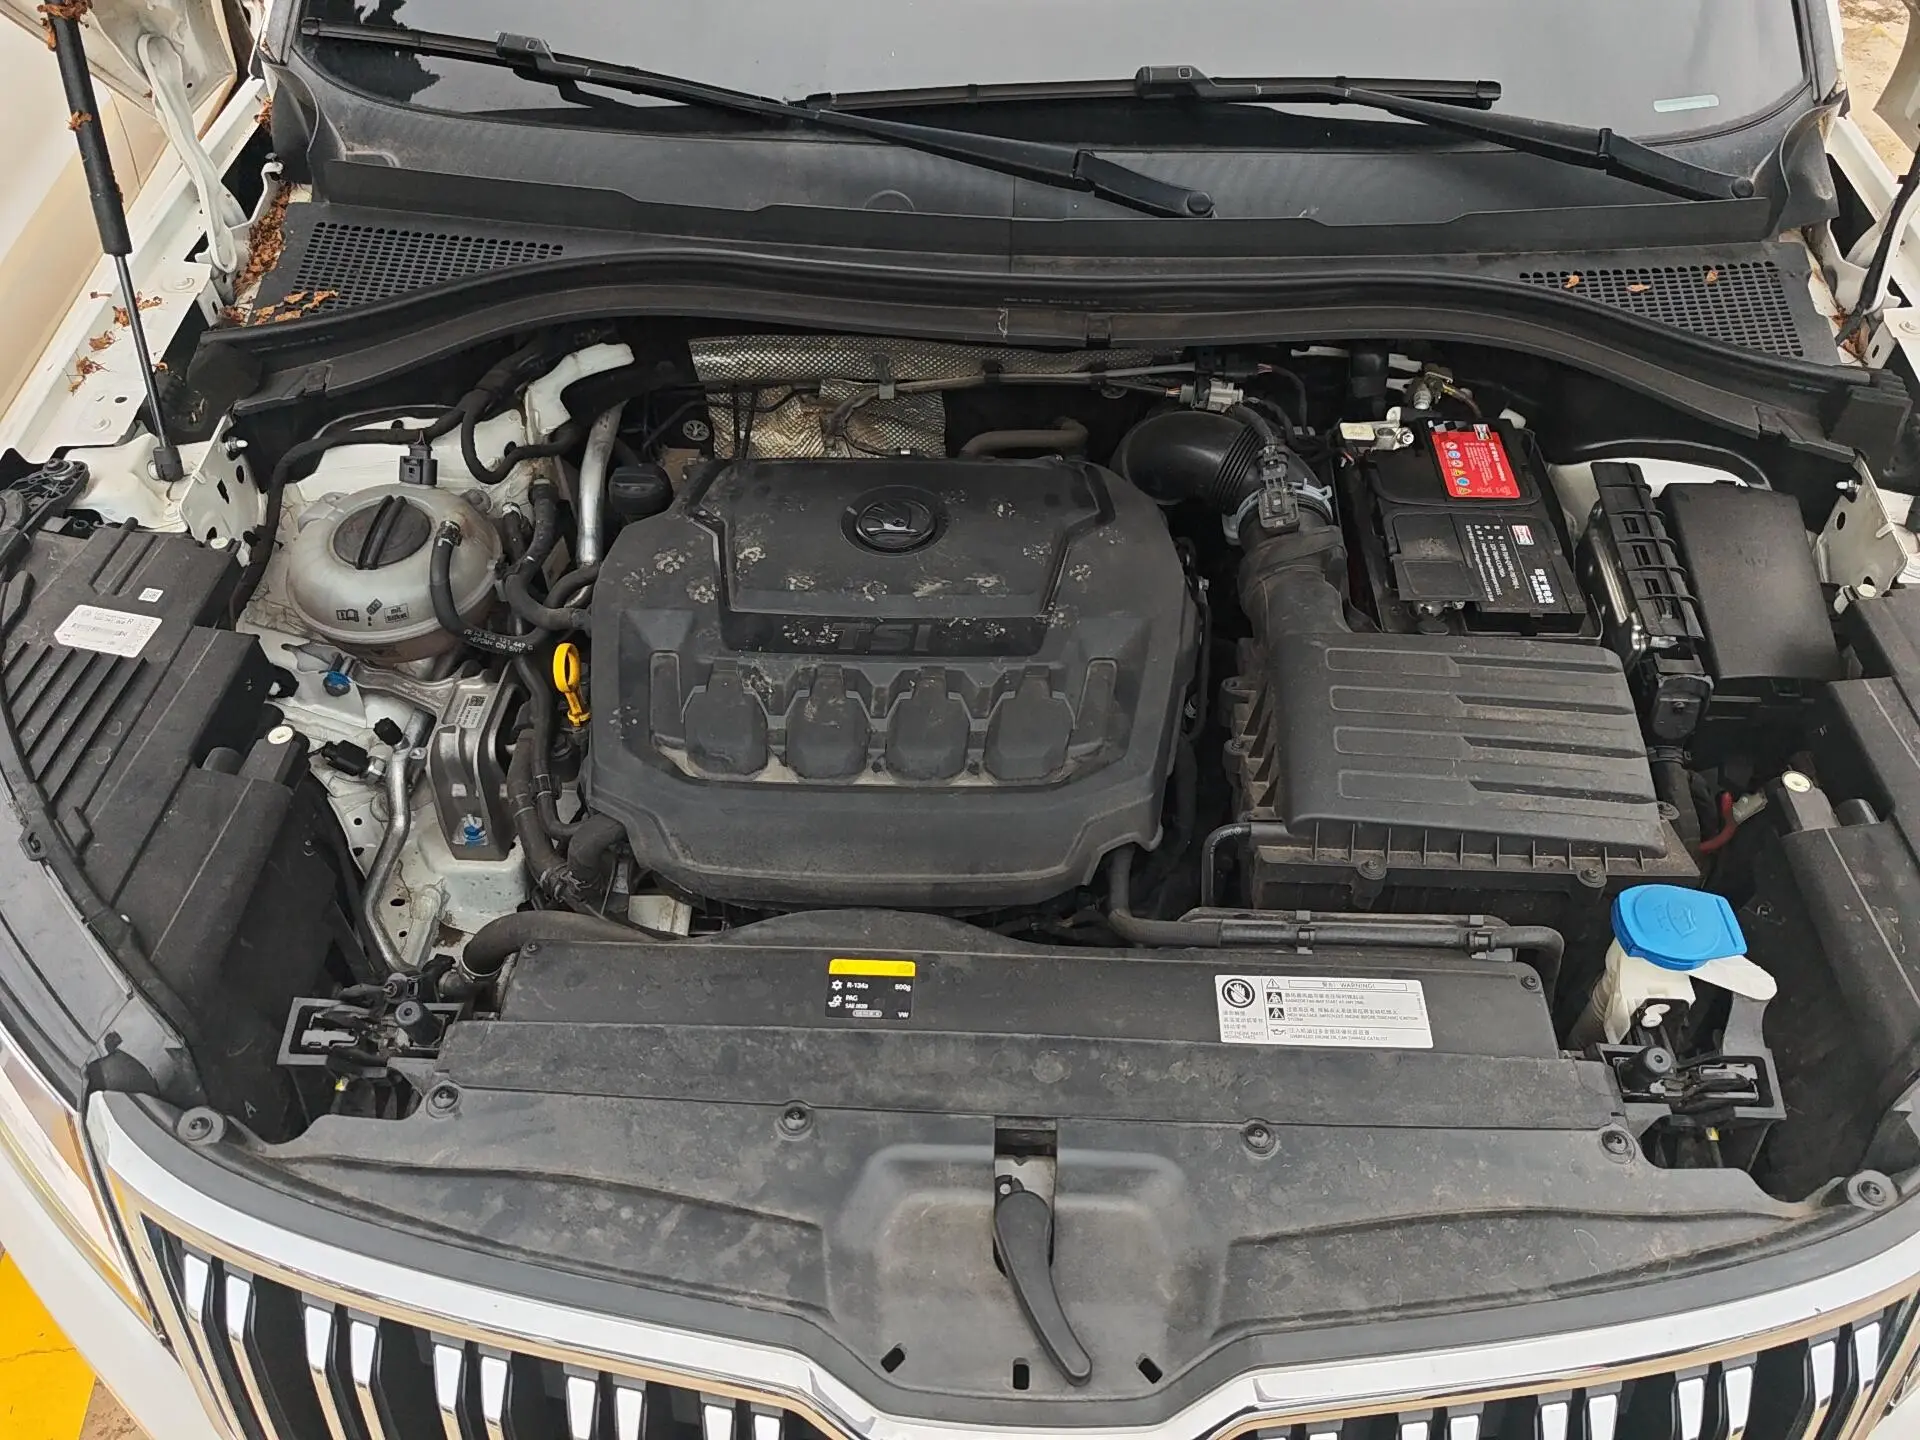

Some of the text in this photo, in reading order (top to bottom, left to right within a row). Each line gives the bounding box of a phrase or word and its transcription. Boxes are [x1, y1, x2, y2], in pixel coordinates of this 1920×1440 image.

[830, 622, 932, 652] TSI
[846, 981, 869, 990] R-134a
[845, 994, 858, 1002] PAG
